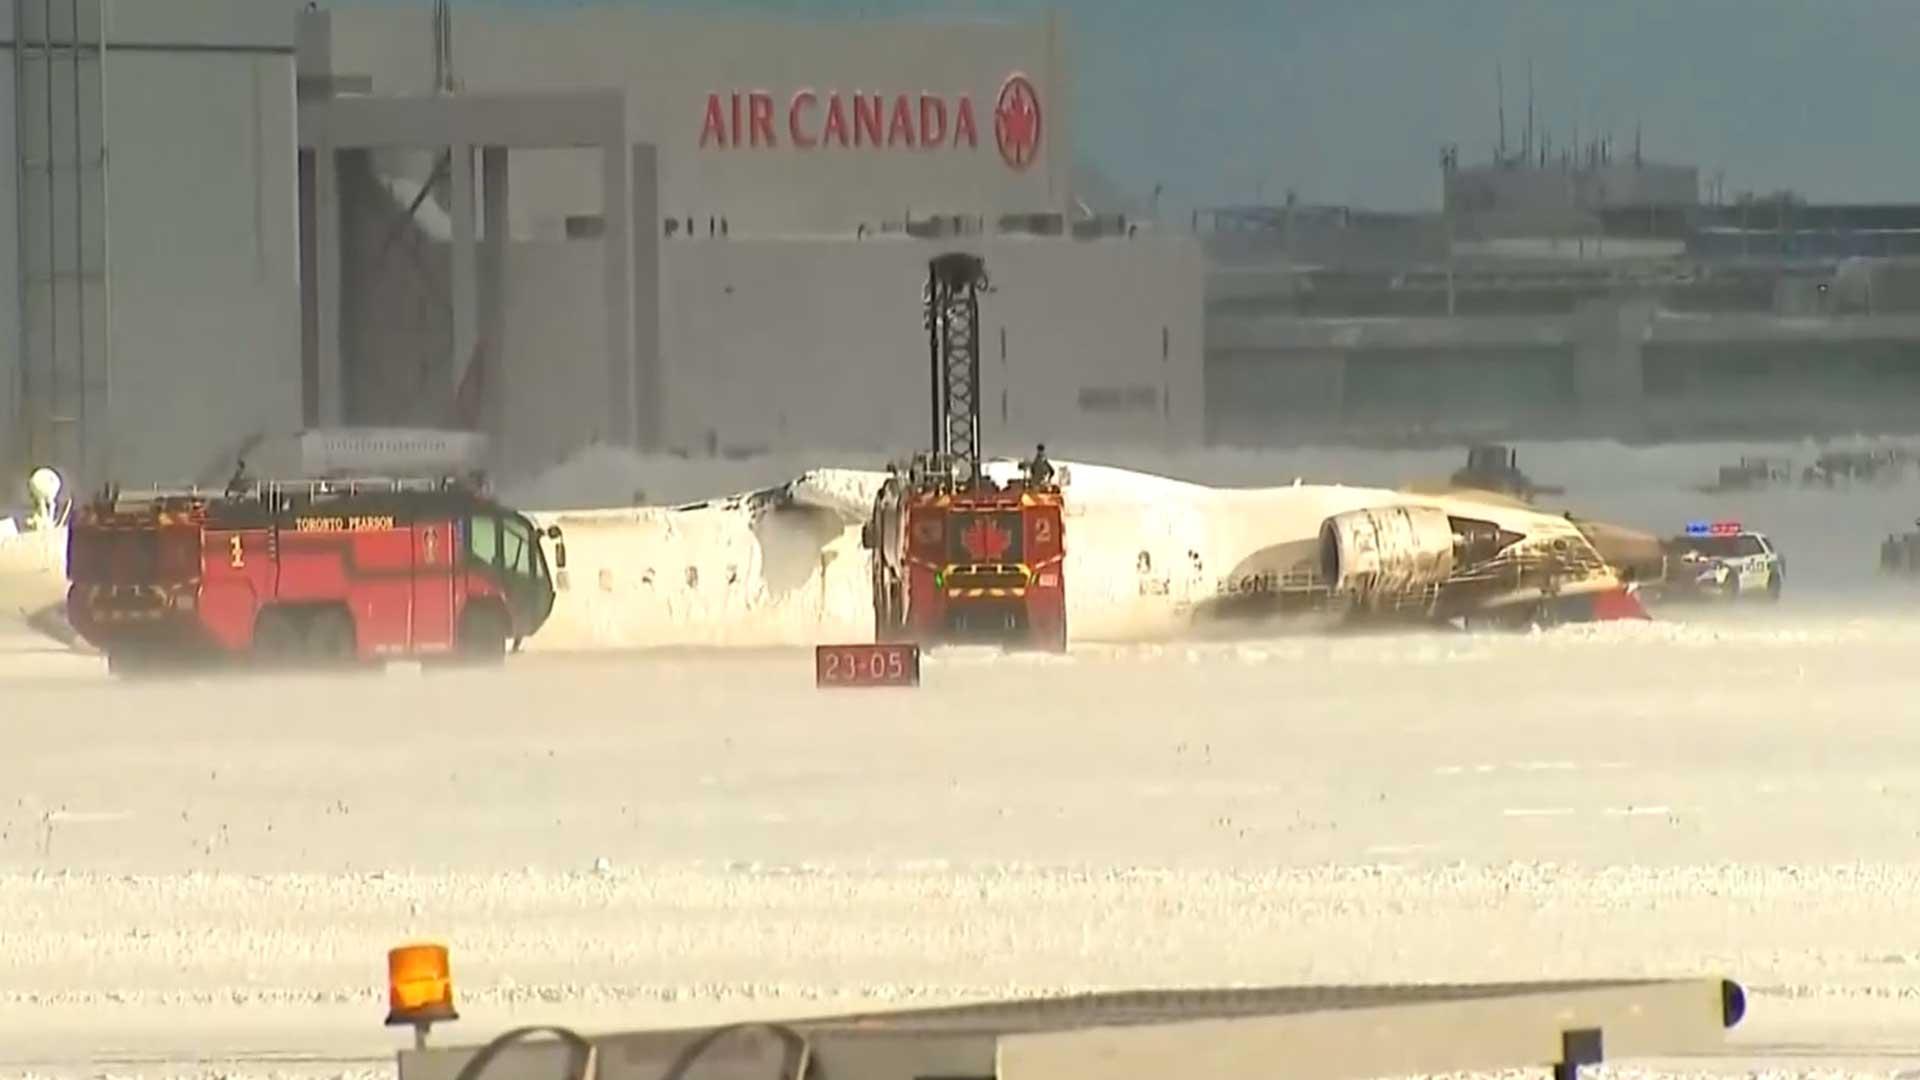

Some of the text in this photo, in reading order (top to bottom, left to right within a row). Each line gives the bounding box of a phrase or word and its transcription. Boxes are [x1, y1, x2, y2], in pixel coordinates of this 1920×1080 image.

[700, 90, 977, 147] AIR CANADA
[296, 516, 394, 532] TORONTO PEARSON
[1036, 518, 1051, 541] 2
[230, 535, 245, 567] 1
[825, 652, 902, 679] 23-05
